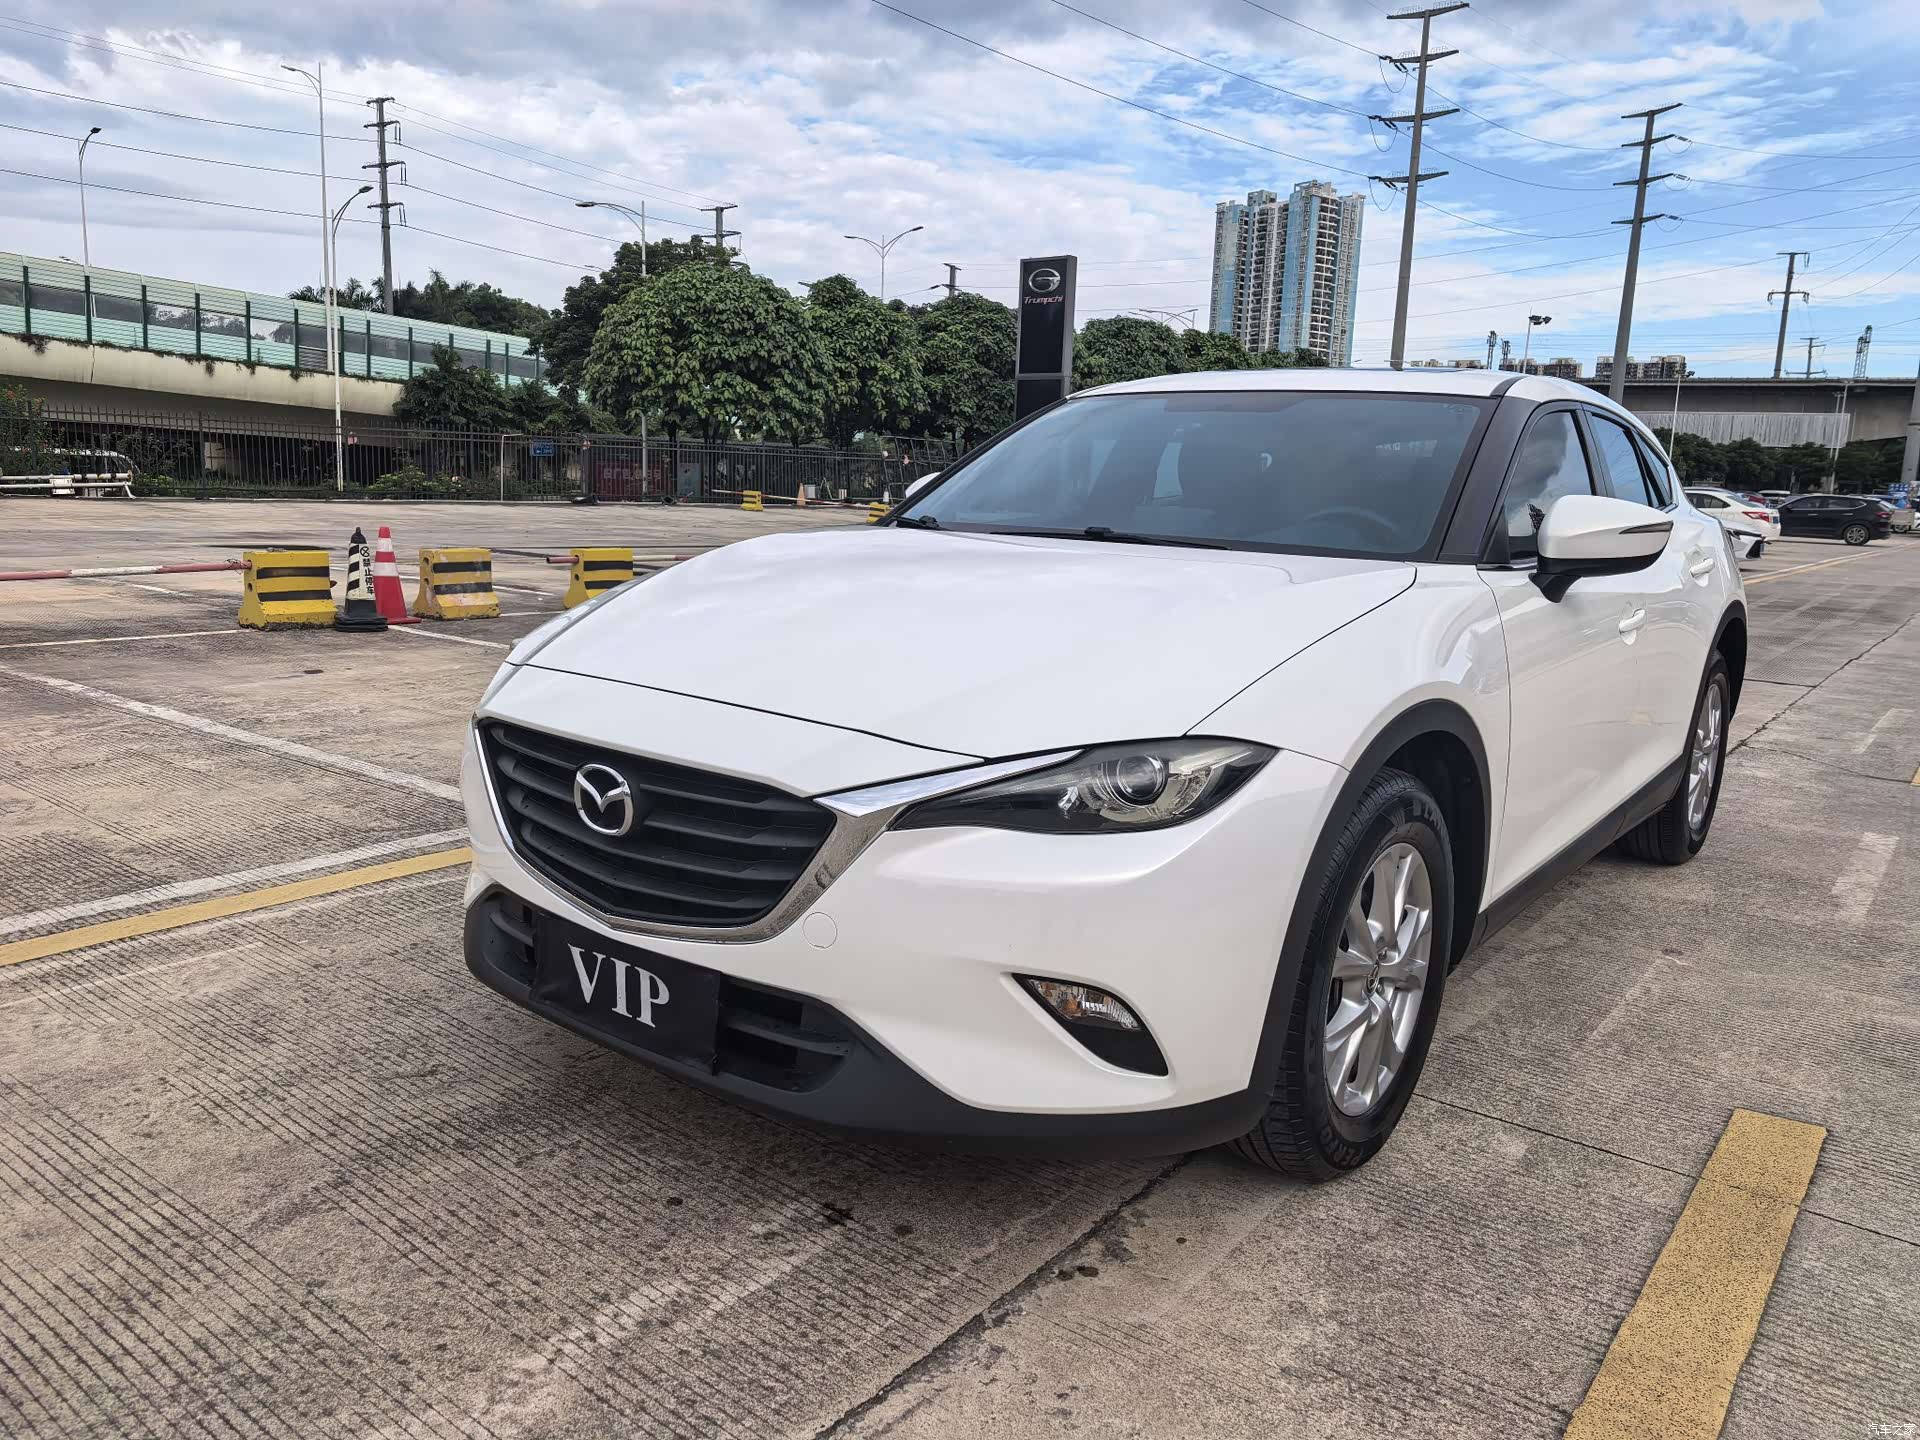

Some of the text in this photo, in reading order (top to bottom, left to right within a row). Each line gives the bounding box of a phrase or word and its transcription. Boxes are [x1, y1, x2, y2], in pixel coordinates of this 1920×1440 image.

[1023, 295, 1064, 305] Trumpchi
[362, 558, 375, 595] 禁止停车
[567, 943, 670, 1028] VIP
